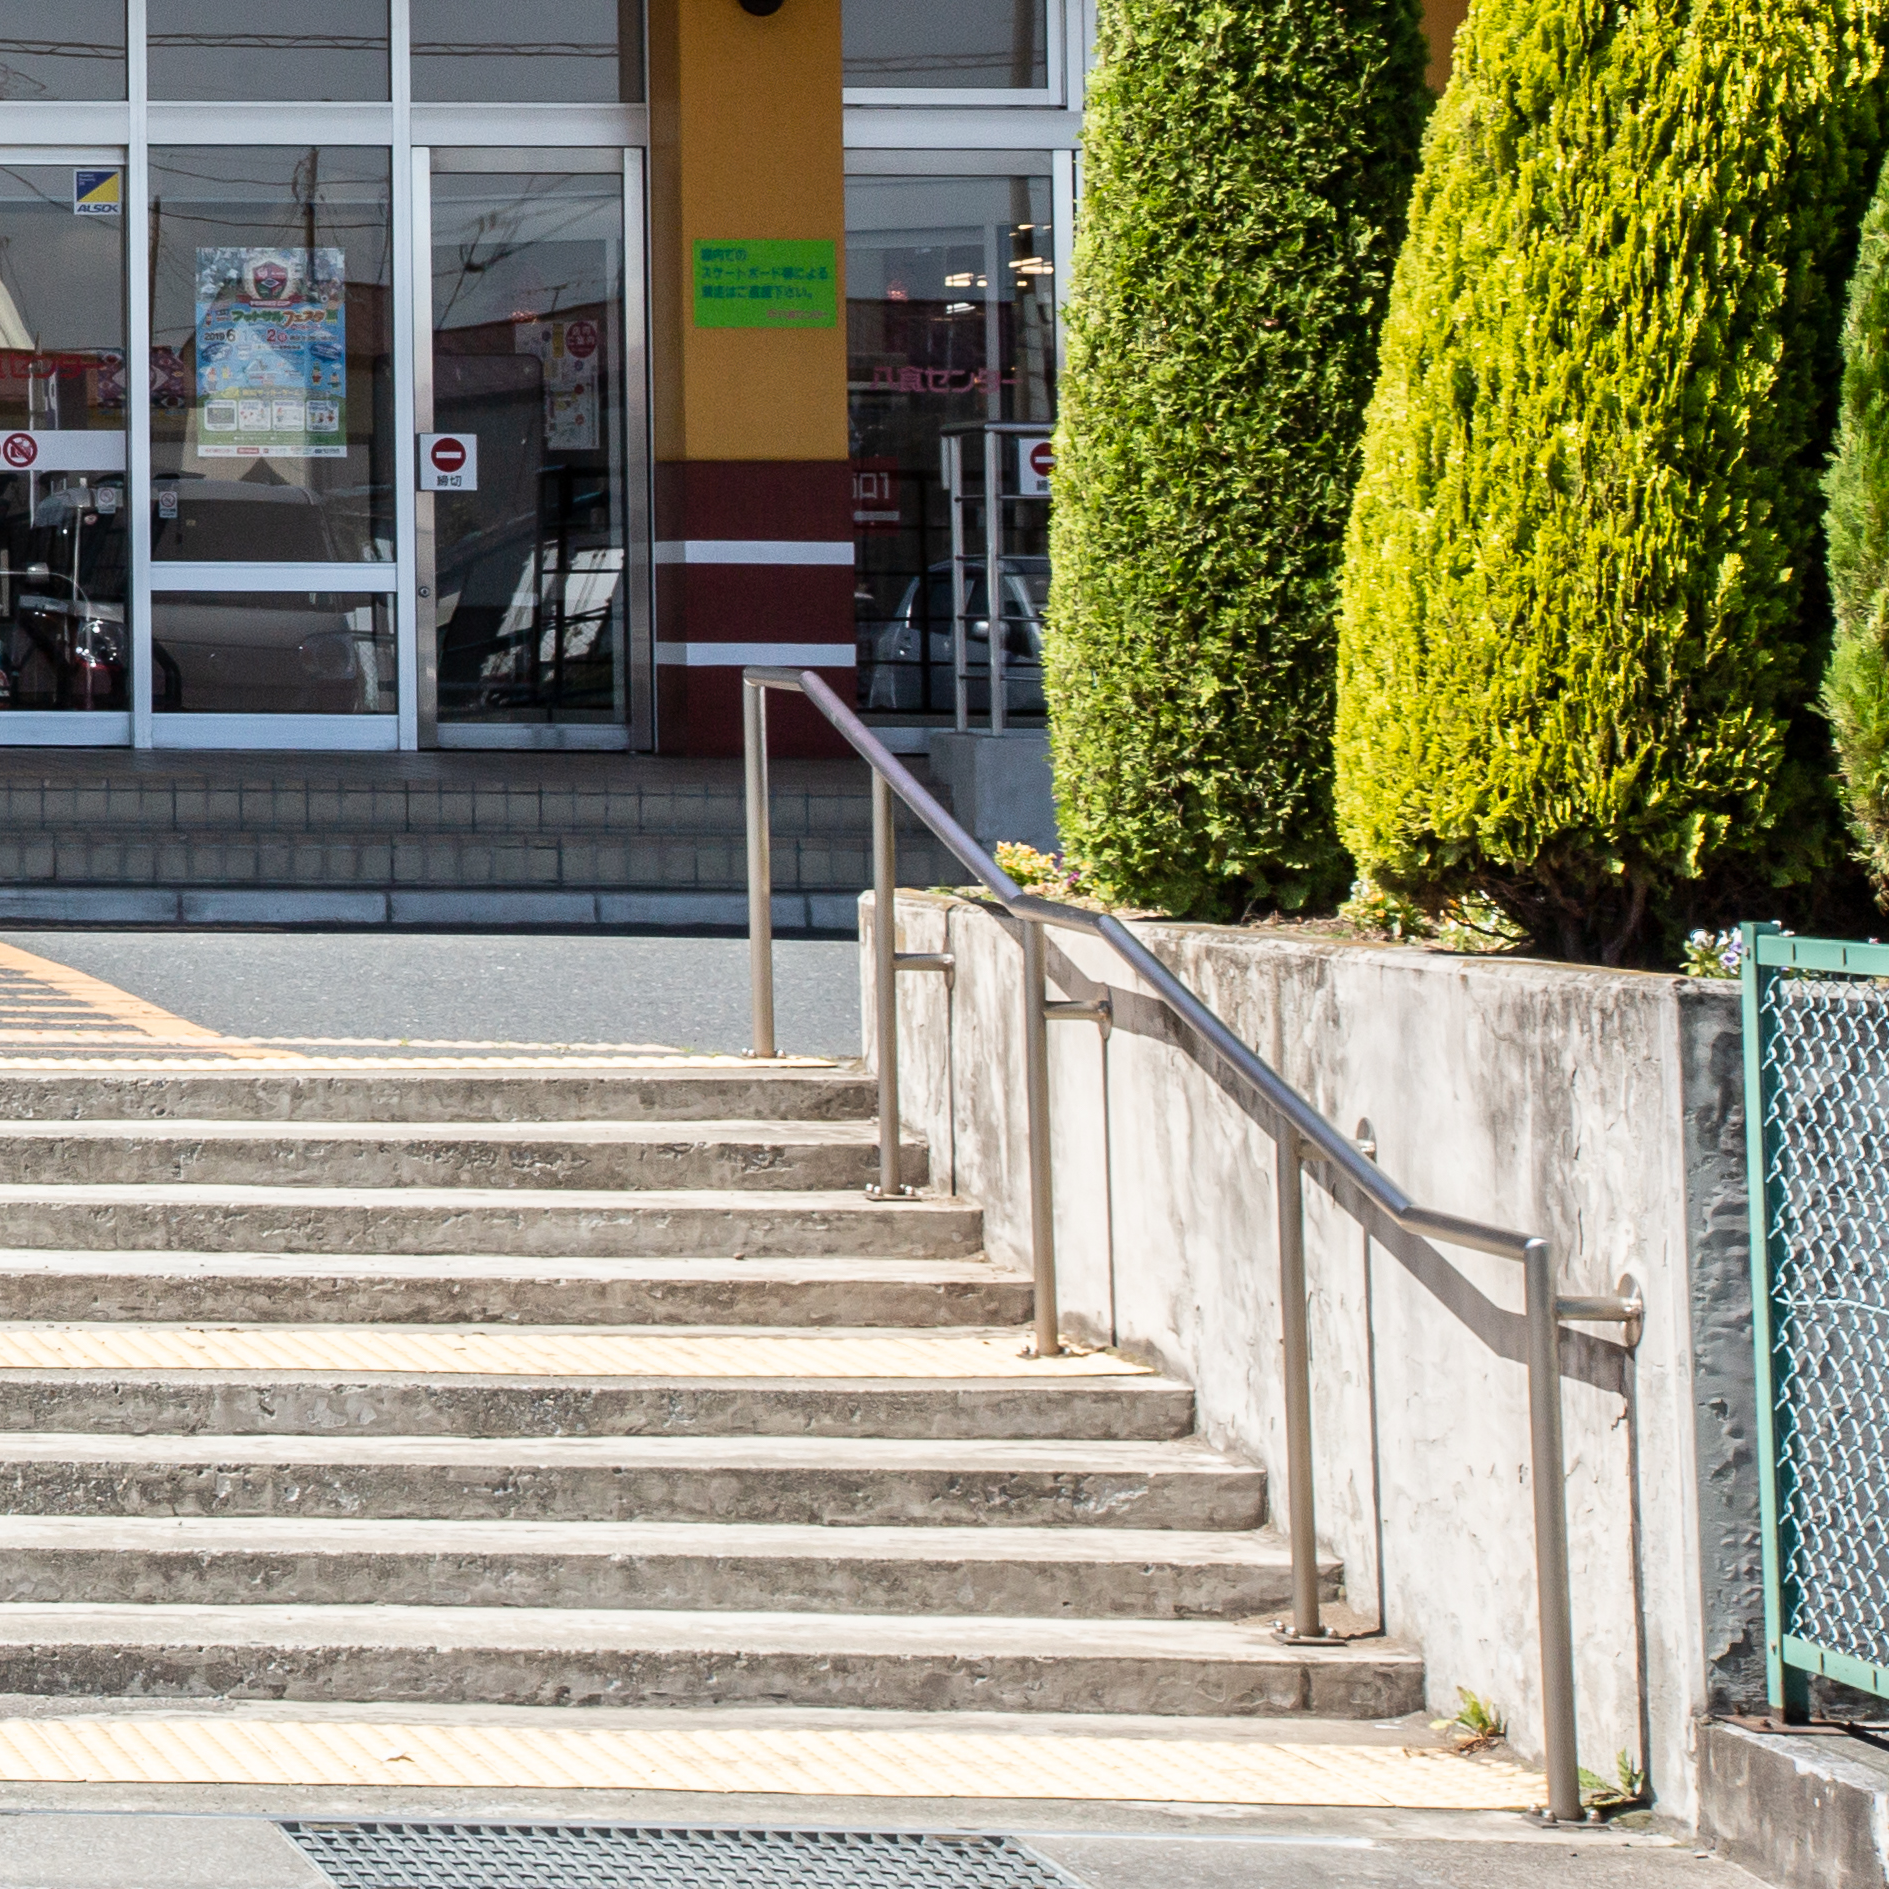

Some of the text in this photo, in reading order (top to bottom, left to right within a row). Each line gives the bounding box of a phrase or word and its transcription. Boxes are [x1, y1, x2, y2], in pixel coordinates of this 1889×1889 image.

[77, 204, 119, 213] ALSOK
[871, 365, 1023, 394] 八食センター
[436, 475, 463, 487] 締切
